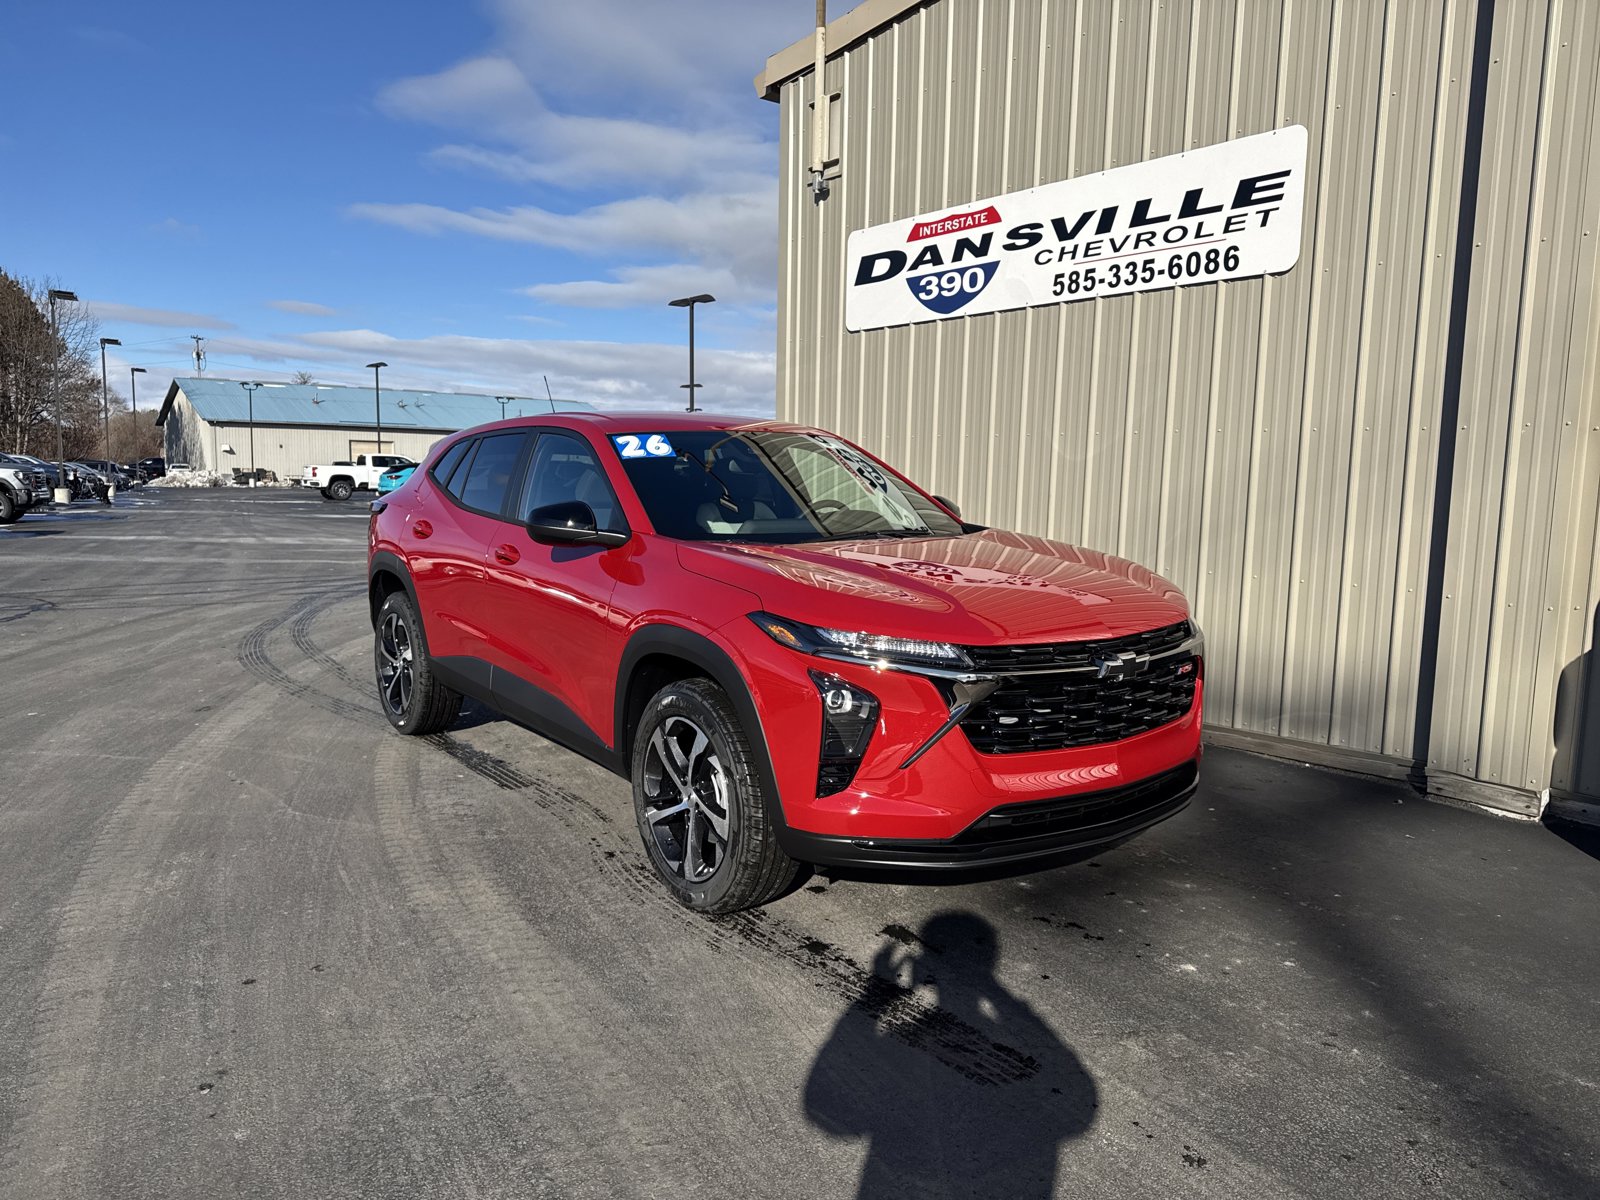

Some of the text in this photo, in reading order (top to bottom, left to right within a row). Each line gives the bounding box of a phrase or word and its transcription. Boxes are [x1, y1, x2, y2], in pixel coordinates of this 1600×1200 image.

[854, 169, 1292, 286] DANSVILLE
[919, 212, 988, 237] INTERSTATE
[1034, 207, 1279, 265] CHEVROLET
[918, 267, 985, 301] 390
[1052, 245, 1240, 296] 585-335-6086
[616, 434, 673, 457] 26
